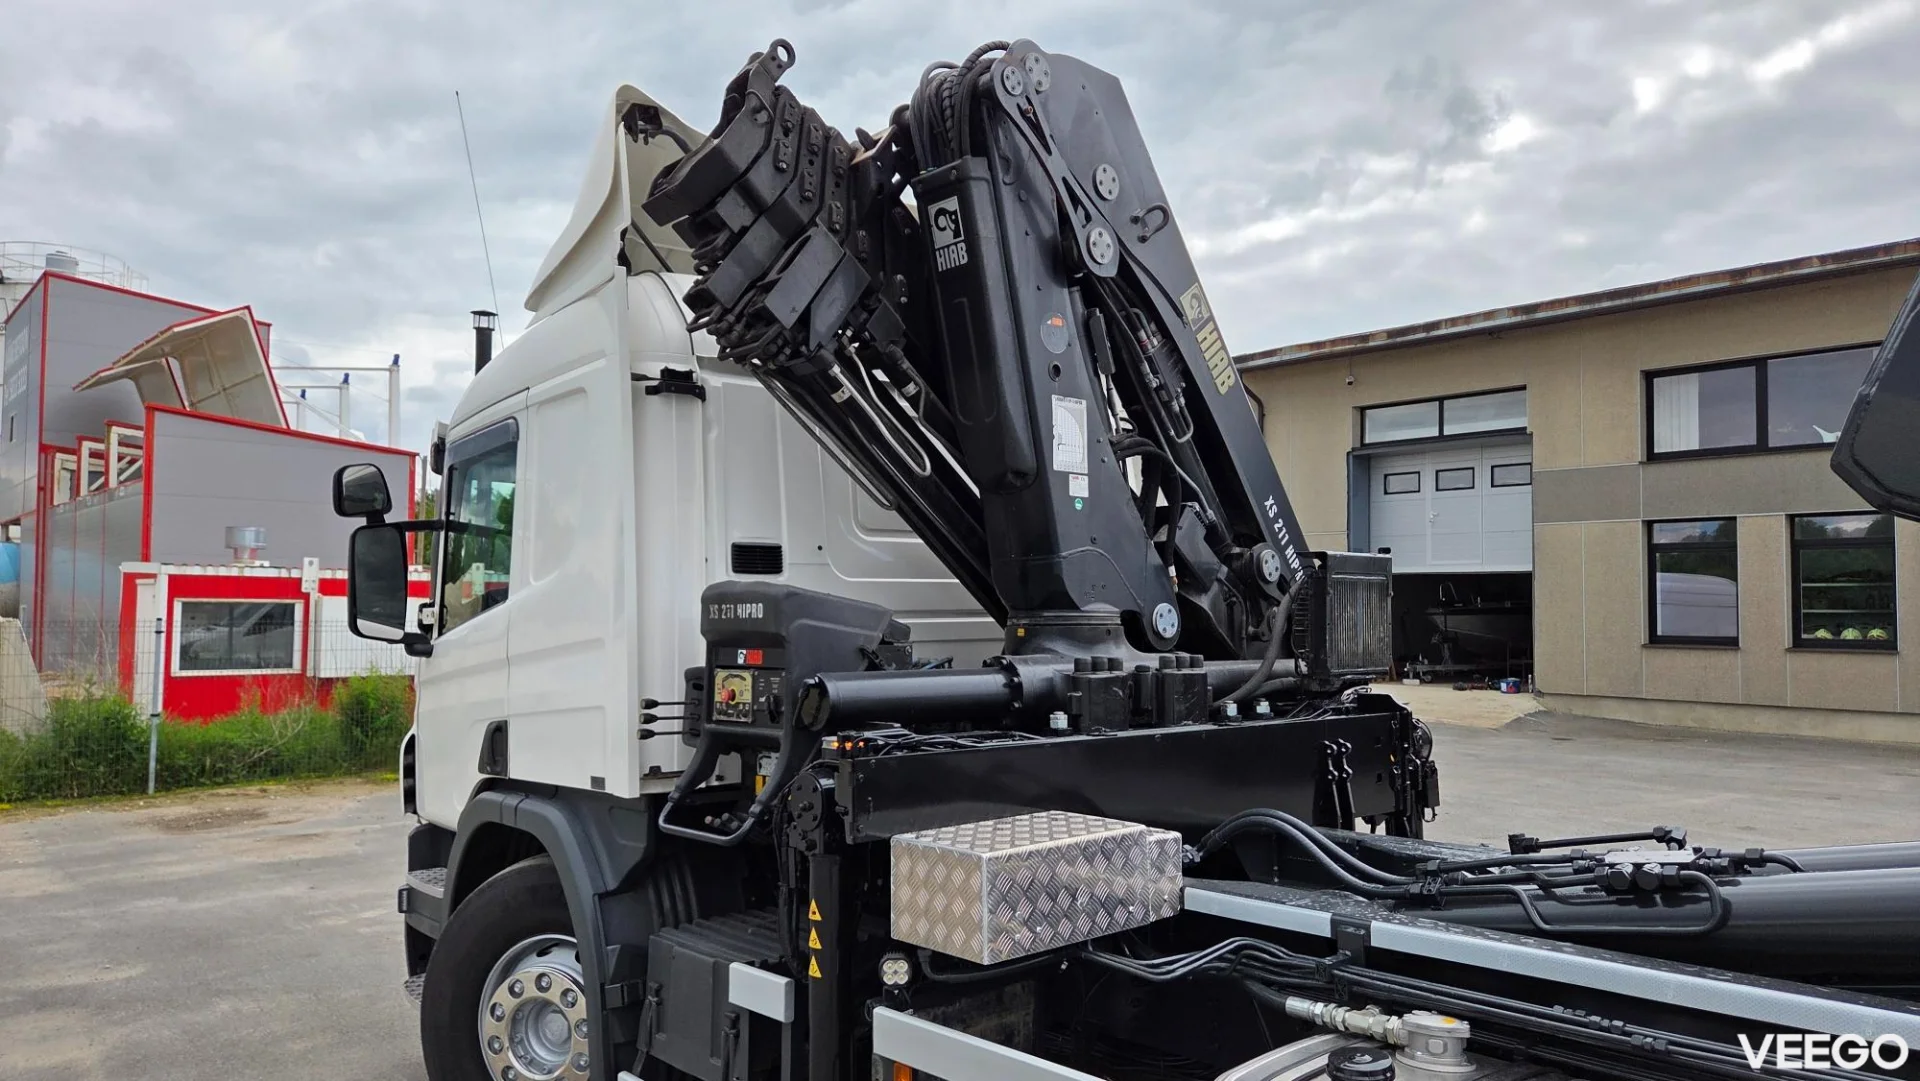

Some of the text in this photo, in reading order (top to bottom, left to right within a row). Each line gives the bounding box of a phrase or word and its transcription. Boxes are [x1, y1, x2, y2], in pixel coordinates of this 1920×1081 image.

[935, 242, 968, 272] HIAB
[1196, 320, 1236, 396] HIAB
[1264, 494, 1306, 582] XS 211 HIPR
[709, 604, 719, 619] XS
[736, 603, 764, 619] HIPRO
